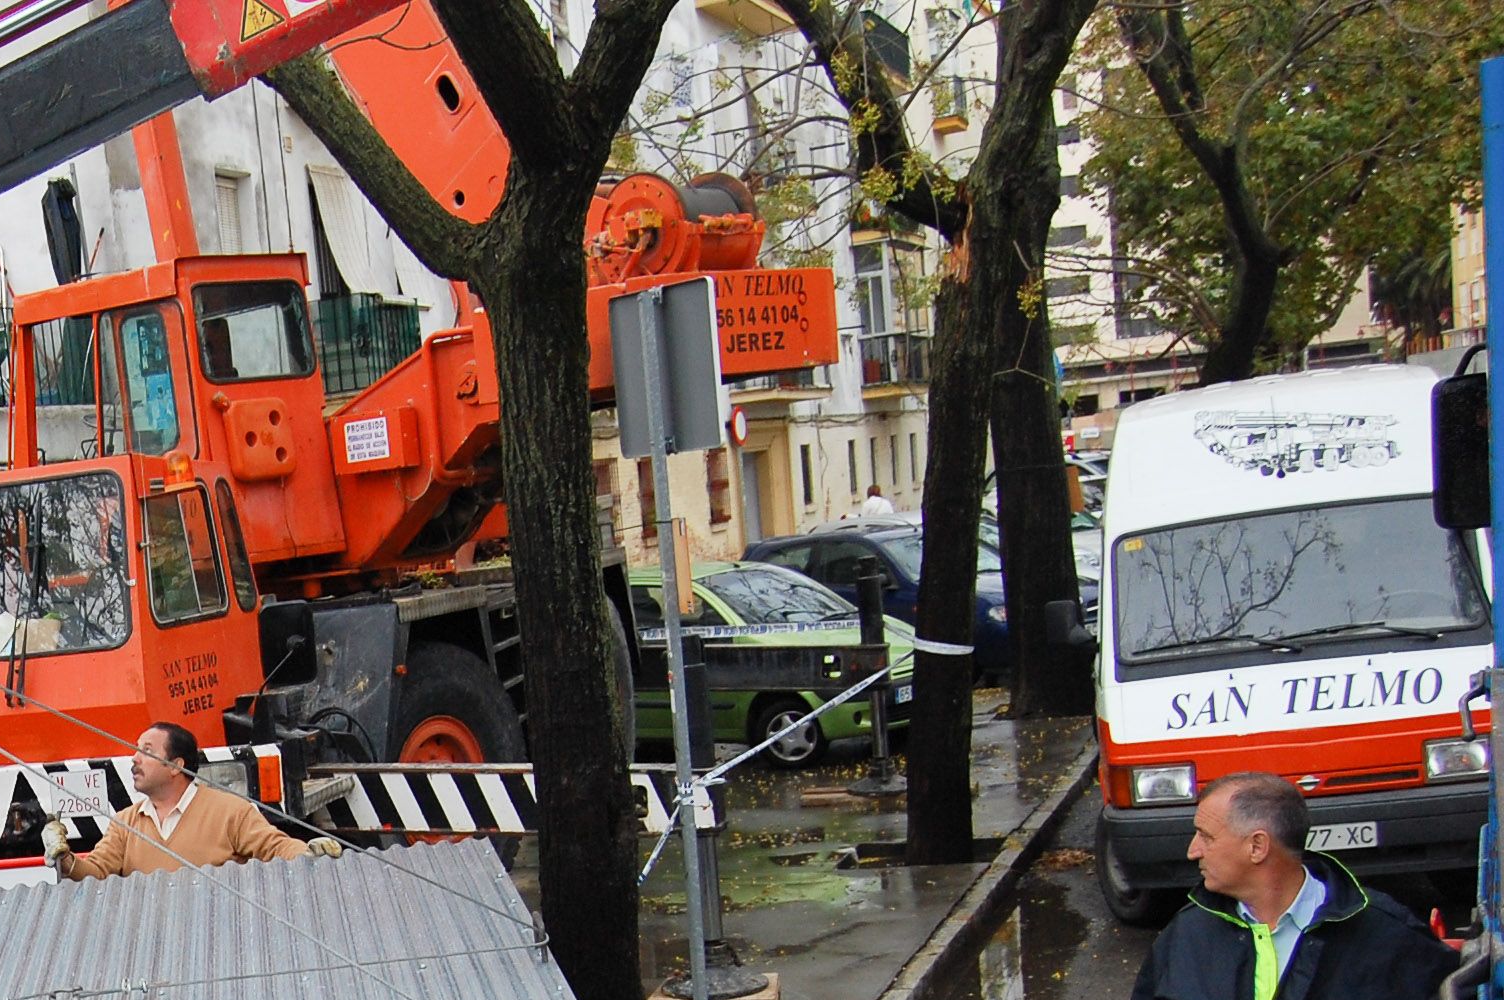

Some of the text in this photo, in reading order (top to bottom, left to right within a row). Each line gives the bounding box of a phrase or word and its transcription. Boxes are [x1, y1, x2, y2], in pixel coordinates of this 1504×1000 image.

[744, 273, 803, 297] TELMO
[726, 331, 785, 353] JEREZ
[183, 693, 214, 715] JEREZ
[1166, 667, 1443, 731] SAN TELMO
[84, 773, 100, 788] VE
